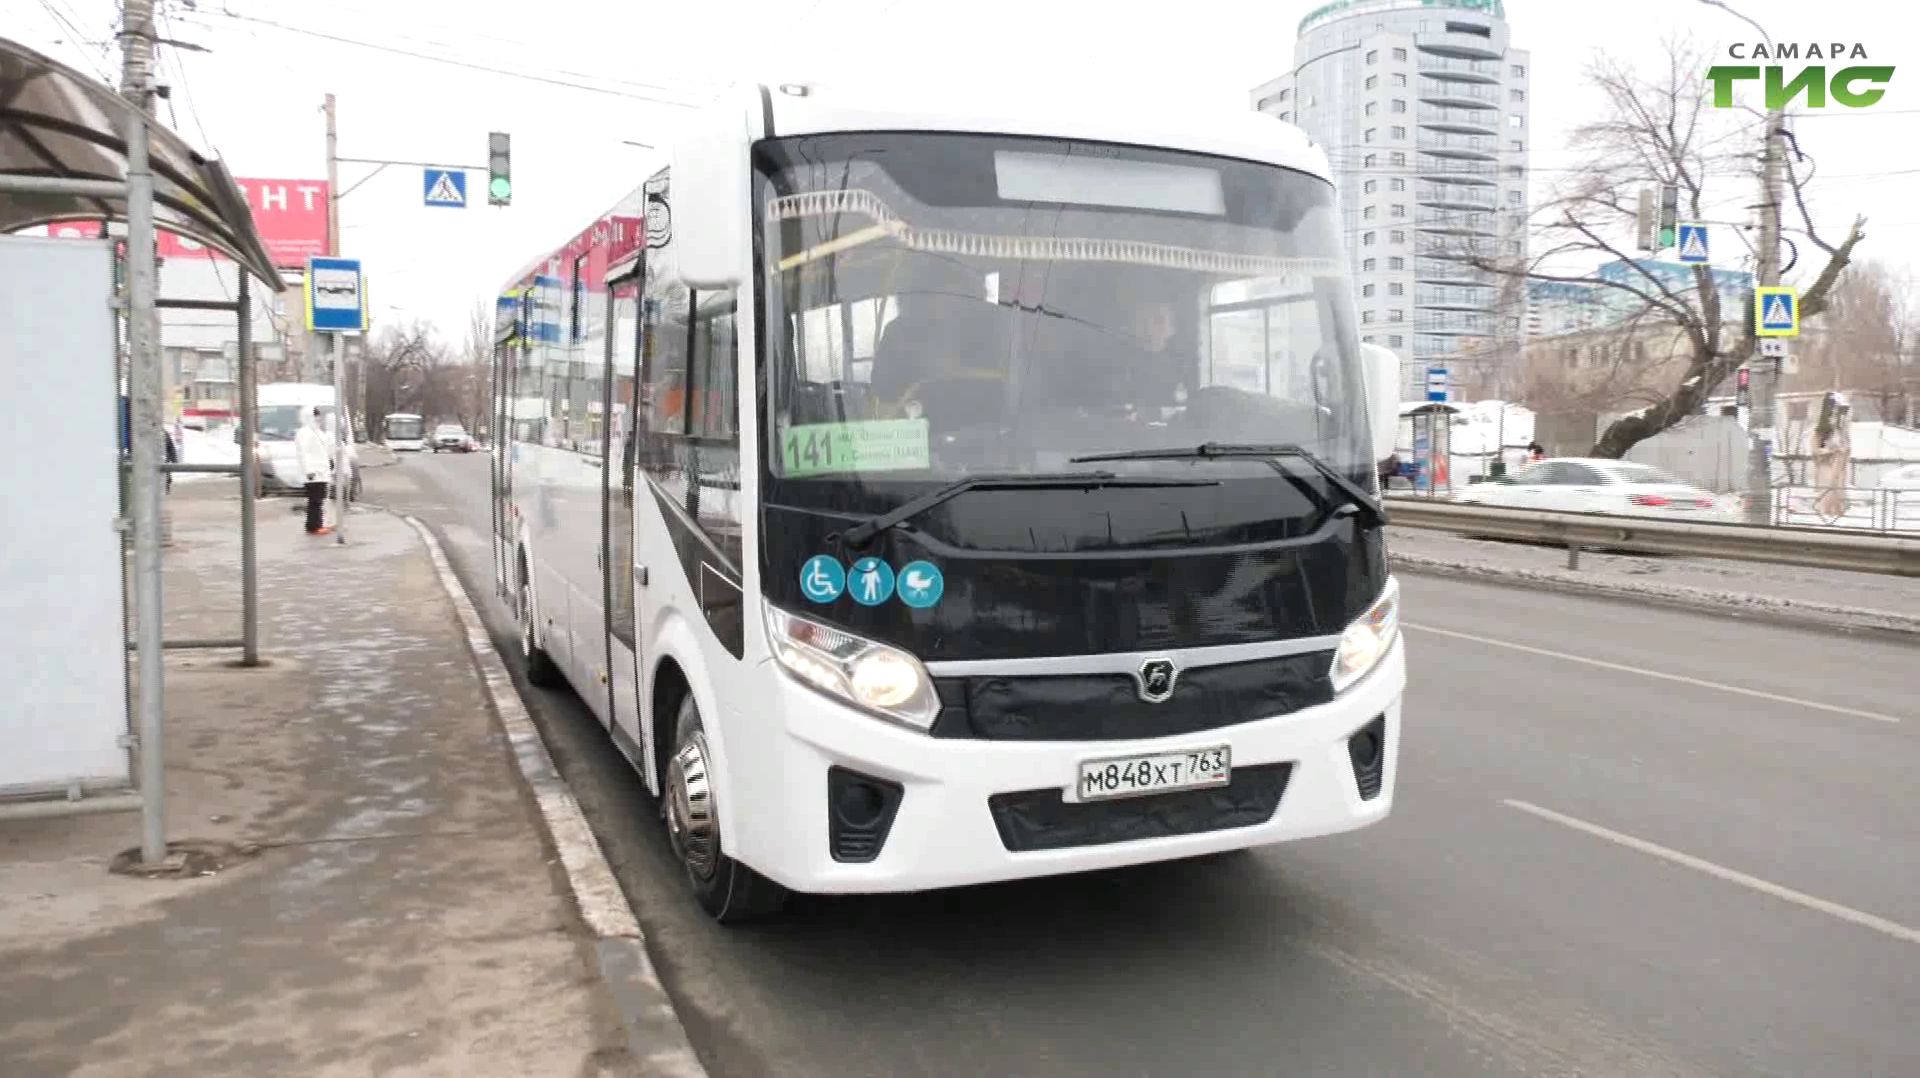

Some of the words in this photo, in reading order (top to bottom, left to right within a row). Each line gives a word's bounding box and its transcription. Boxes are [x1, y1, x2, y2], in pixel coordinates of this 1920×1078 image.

[238, 184, 319, 211] НТ
[788, 431, 832, 469] 141
[1087, 761, 1181, 791] М848ХТ
[1189, 752, 1222, 773] 763
